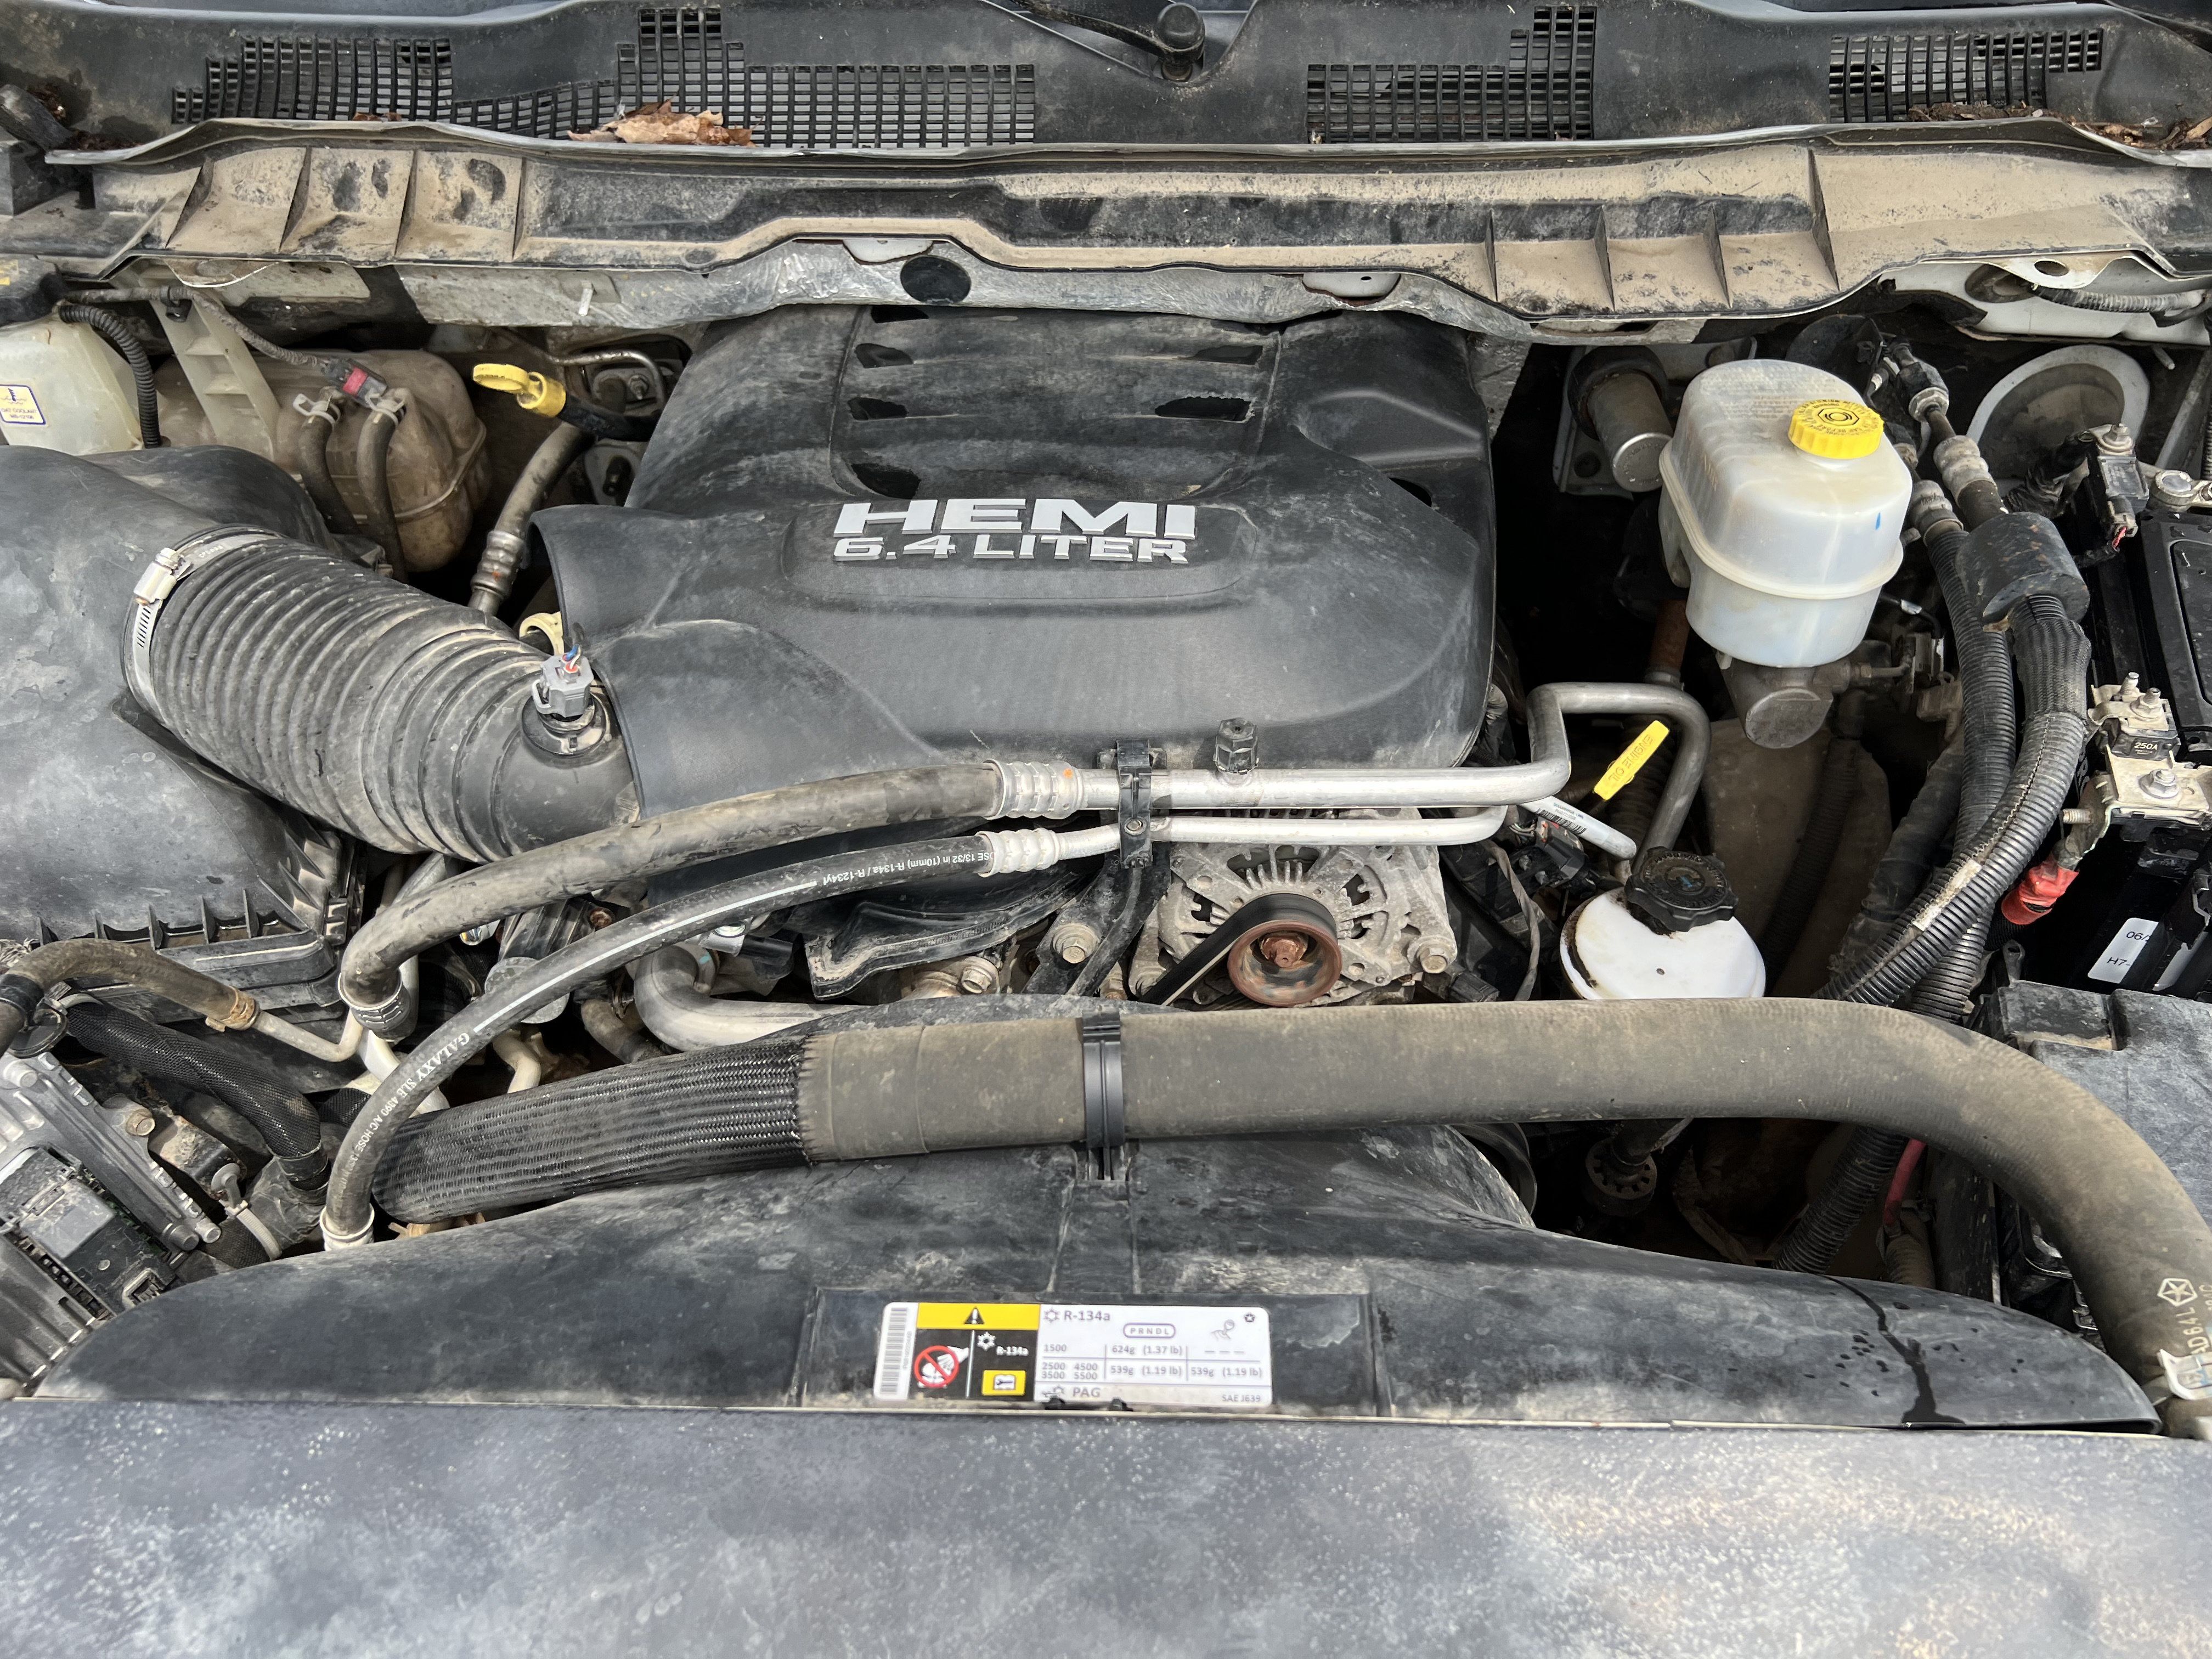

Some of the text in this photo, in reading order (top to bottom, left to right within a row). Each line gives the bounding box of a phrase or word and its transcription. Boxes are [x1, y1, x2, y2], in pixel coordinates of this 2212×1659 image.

[833, 498, 1196, 539] HEMI
[833, 535, 1188, 563] 6.4 LITER
[2133, 742, 2158, 751] 250A
[1608, 734, 1654, 782] ENGINE OIL
[907, 855, 940, 870] (10mm)
[952, 851, 975, 863] 13/32
[872, 863, 905, 874] R-134a
[822, 870, 866, 885] R-1234yf
[2126, 931, 2151, 943] 06/
[416, 1032, 470, 1081] GALAXY
[369, 1114, 383, 1131] A/C
[355, 1128, 374, 1152] HOSE
[1064, 1310, 1110, 1322] R-134a
[996, 1346, 1029, 1356] R-134a
[1043, 1344, 1183, 1356] 1500 624g (1.37 lb)
[1042, 1362, 1098, 1371] 2500 4500
[1110, 1365, 1182, 1376] 539g (1.19 lb)
[1190, 1367, 1263, 1378] 539g (1.19 lb)
[1073, 1372, 1098, 1380] 5500
[1072, 1387, 1101, 1398] PAG
[1221, 1394, 1261, 1403] SAE J639
